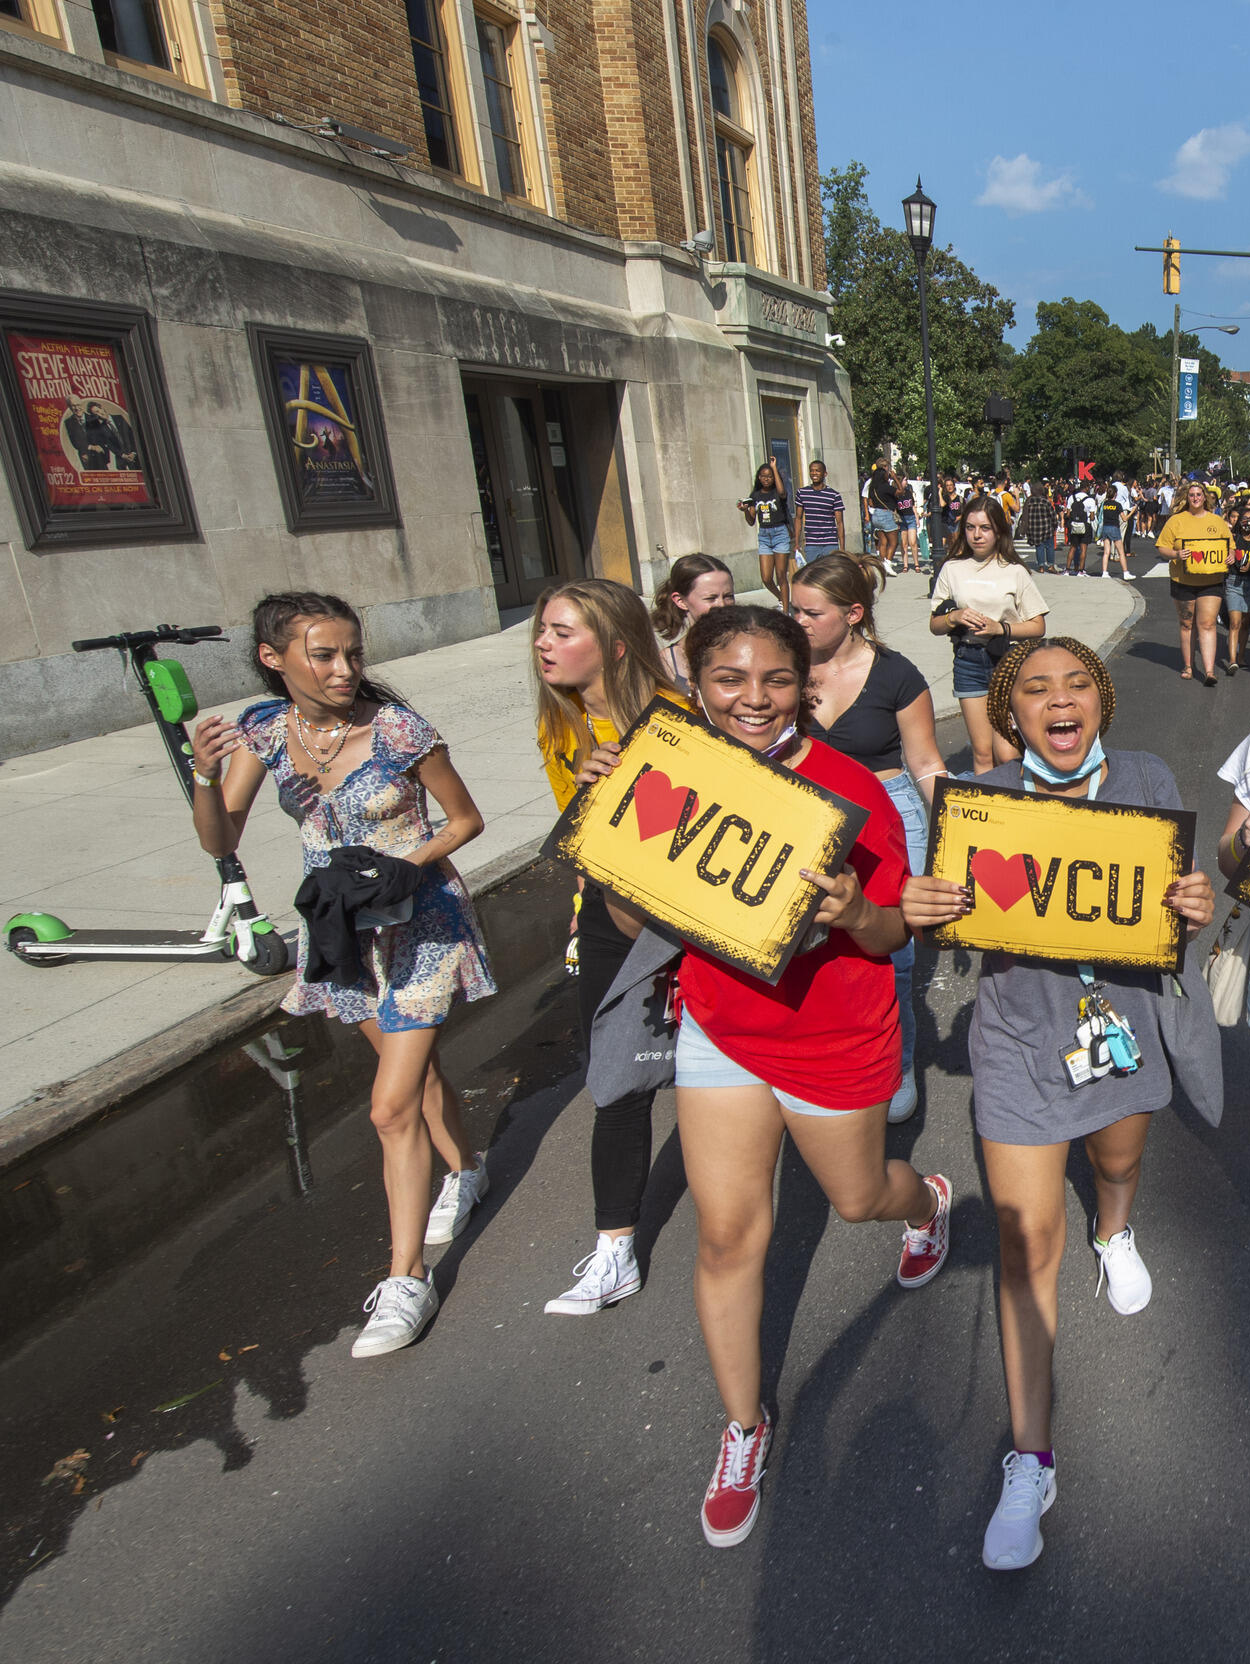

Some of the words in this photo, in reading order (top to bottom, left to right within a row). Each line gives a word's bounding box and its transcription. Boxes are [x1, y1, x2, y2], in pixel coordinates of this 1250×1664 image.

[41, 342, 70, 353] ALTRIA
[72, 345, 111, 357] THEATER
[17, 351, 69, 379] STEVE
[66, 355, 115, 379] MARTIN
[24, 379, 73, 400] MARTIN
[72, 375, 119, 404] SHORT
[305, 456, 356, 471] ANASTASIA
[1078, 461, 1096, 480] K
[47, 472, 65, 485] OCT
[64, 472, 76, 485] 22
[58, 486, 90, 494] TICKETS
[1202, 550, 1223, 565] VCU
[657, 727, 681, 747] VCU
[962, 807, 989, 822] VCU
[608, 761, 653, 828] I
[667, 787, 795, 908] VCU
[965, 845, 978, 910] I
[1022, 853, 1145, 927] VCU
